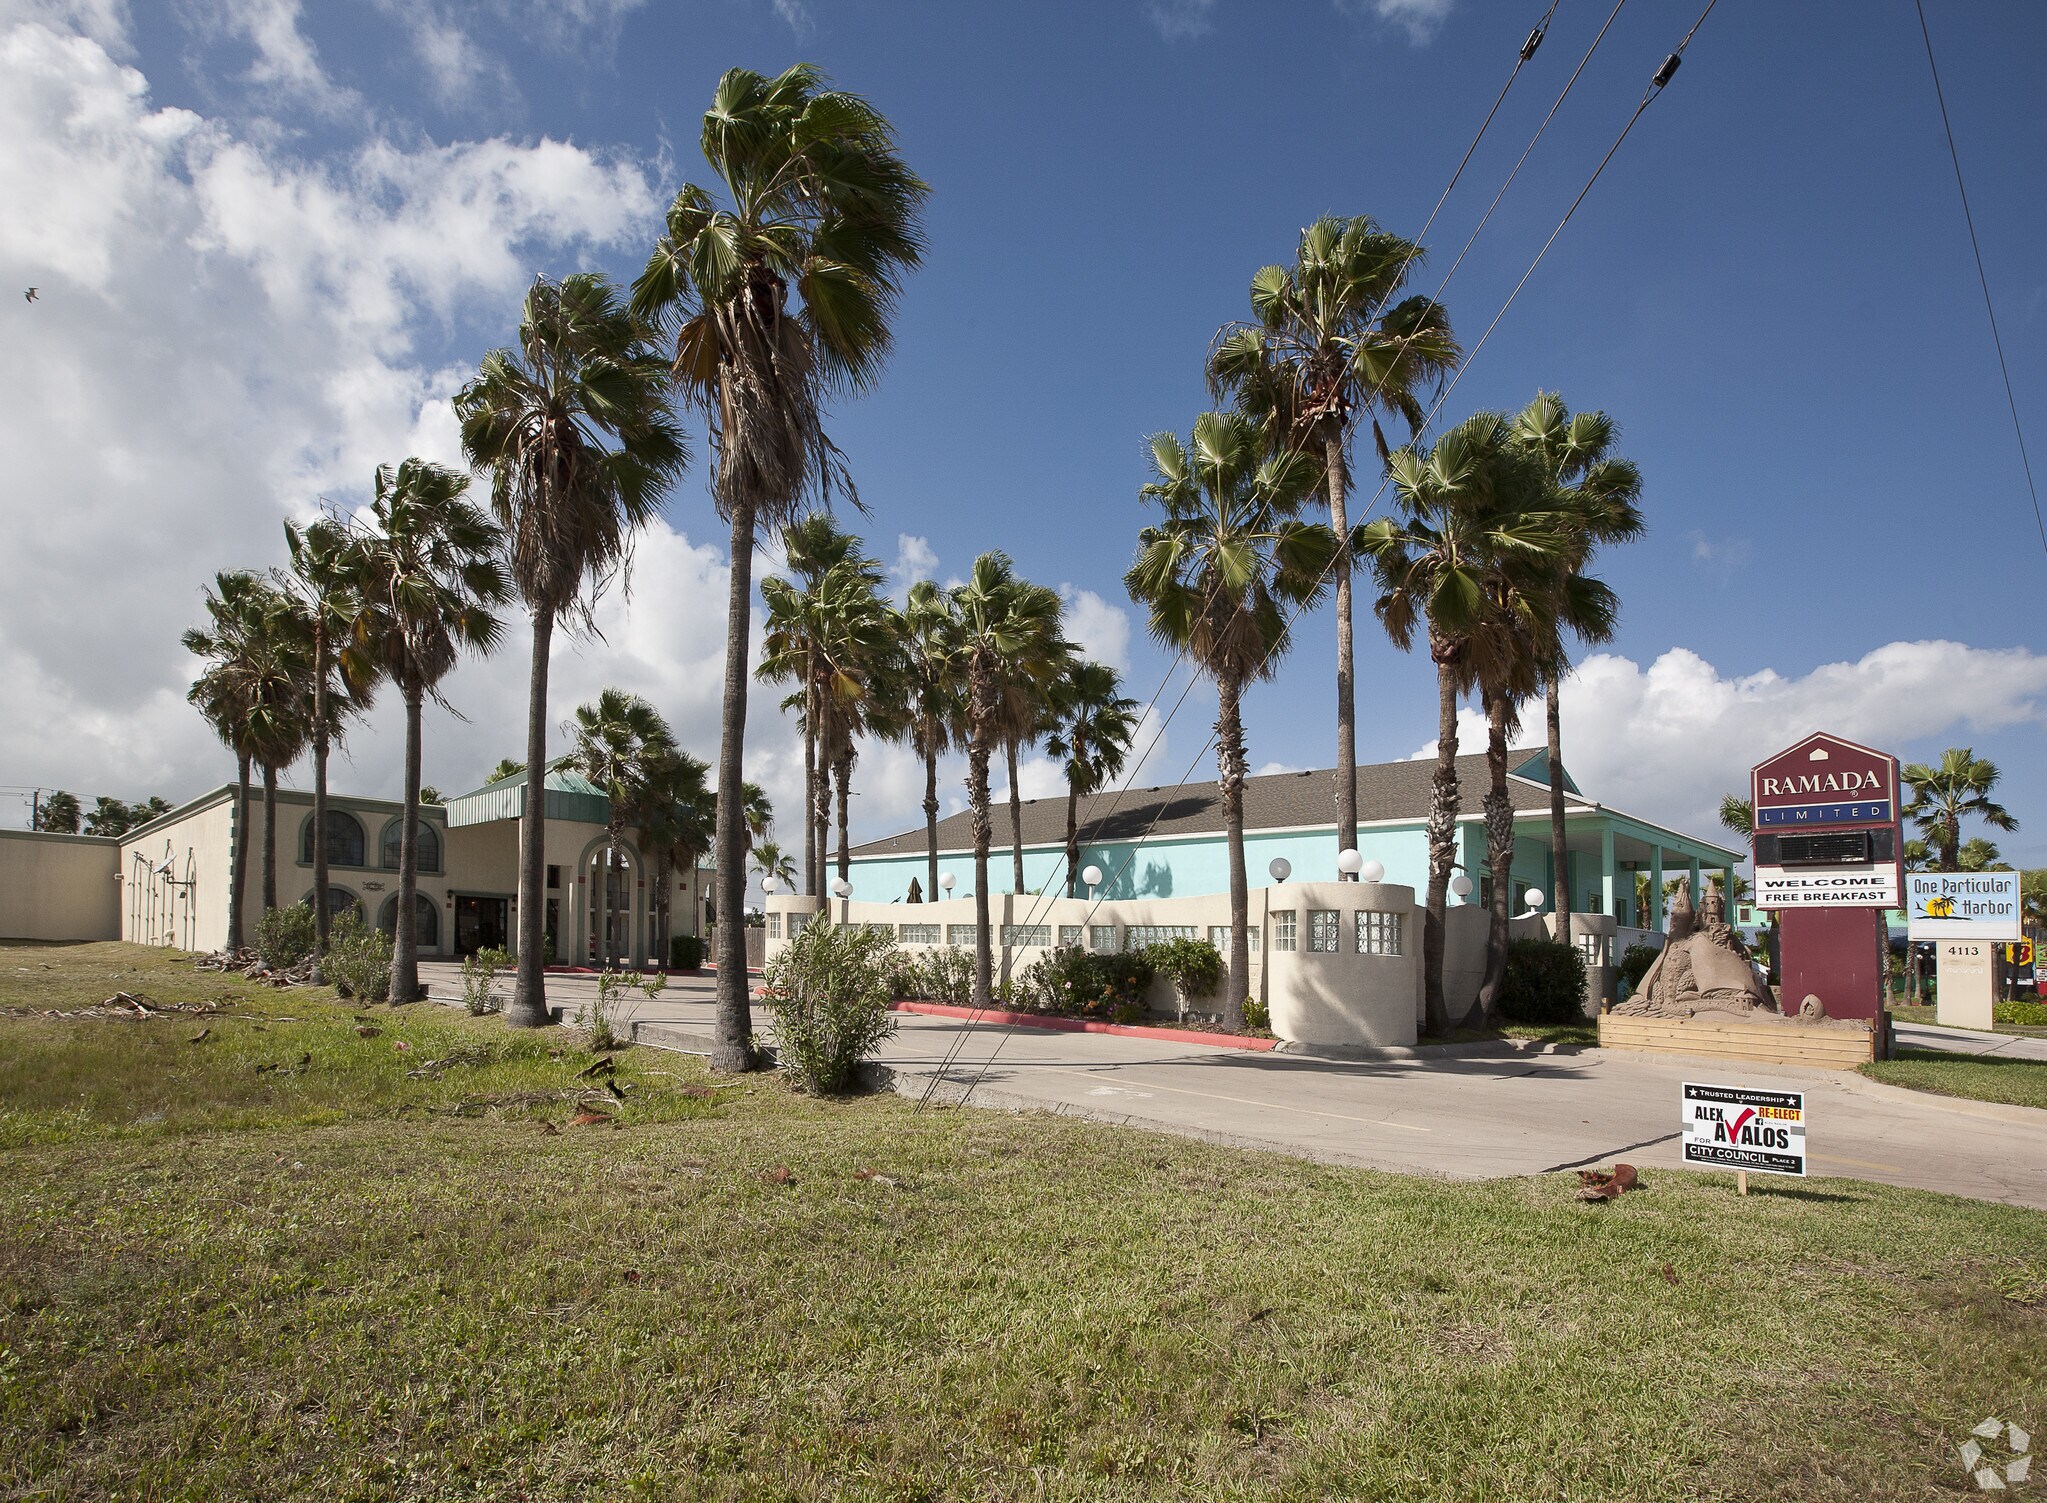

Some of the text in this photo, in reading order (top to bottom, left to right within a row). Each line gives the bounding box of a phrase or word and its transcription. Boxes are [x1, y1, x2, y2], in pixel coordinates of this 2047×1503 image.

[1762, 770, 1881, 796] RAMADA
[1765, 806, 1880, 822] LIMITED
[1765, 877, 1885, 888] WELCOME
[1914, 877, 2012, 894] One Particular
[1765, 891, 1886, 902] FREE BREAKFAST
[1962, 899, 2013, 915] Harbor
[1948, 946, 1979, 956] 4113
[1699, 1089, 1785, 1103] TRUSTED LEADERSHIP
[1695, 1106, 1724, 1122] ALEX
[1758, 1107, 1801, 1121] RE-ELECT
[1694, 1136, 1711, 1145] FOR
[1689, 1145, 1714, 1156] CITY
[1716, 1149, 1769, 1164] COUNCIL
